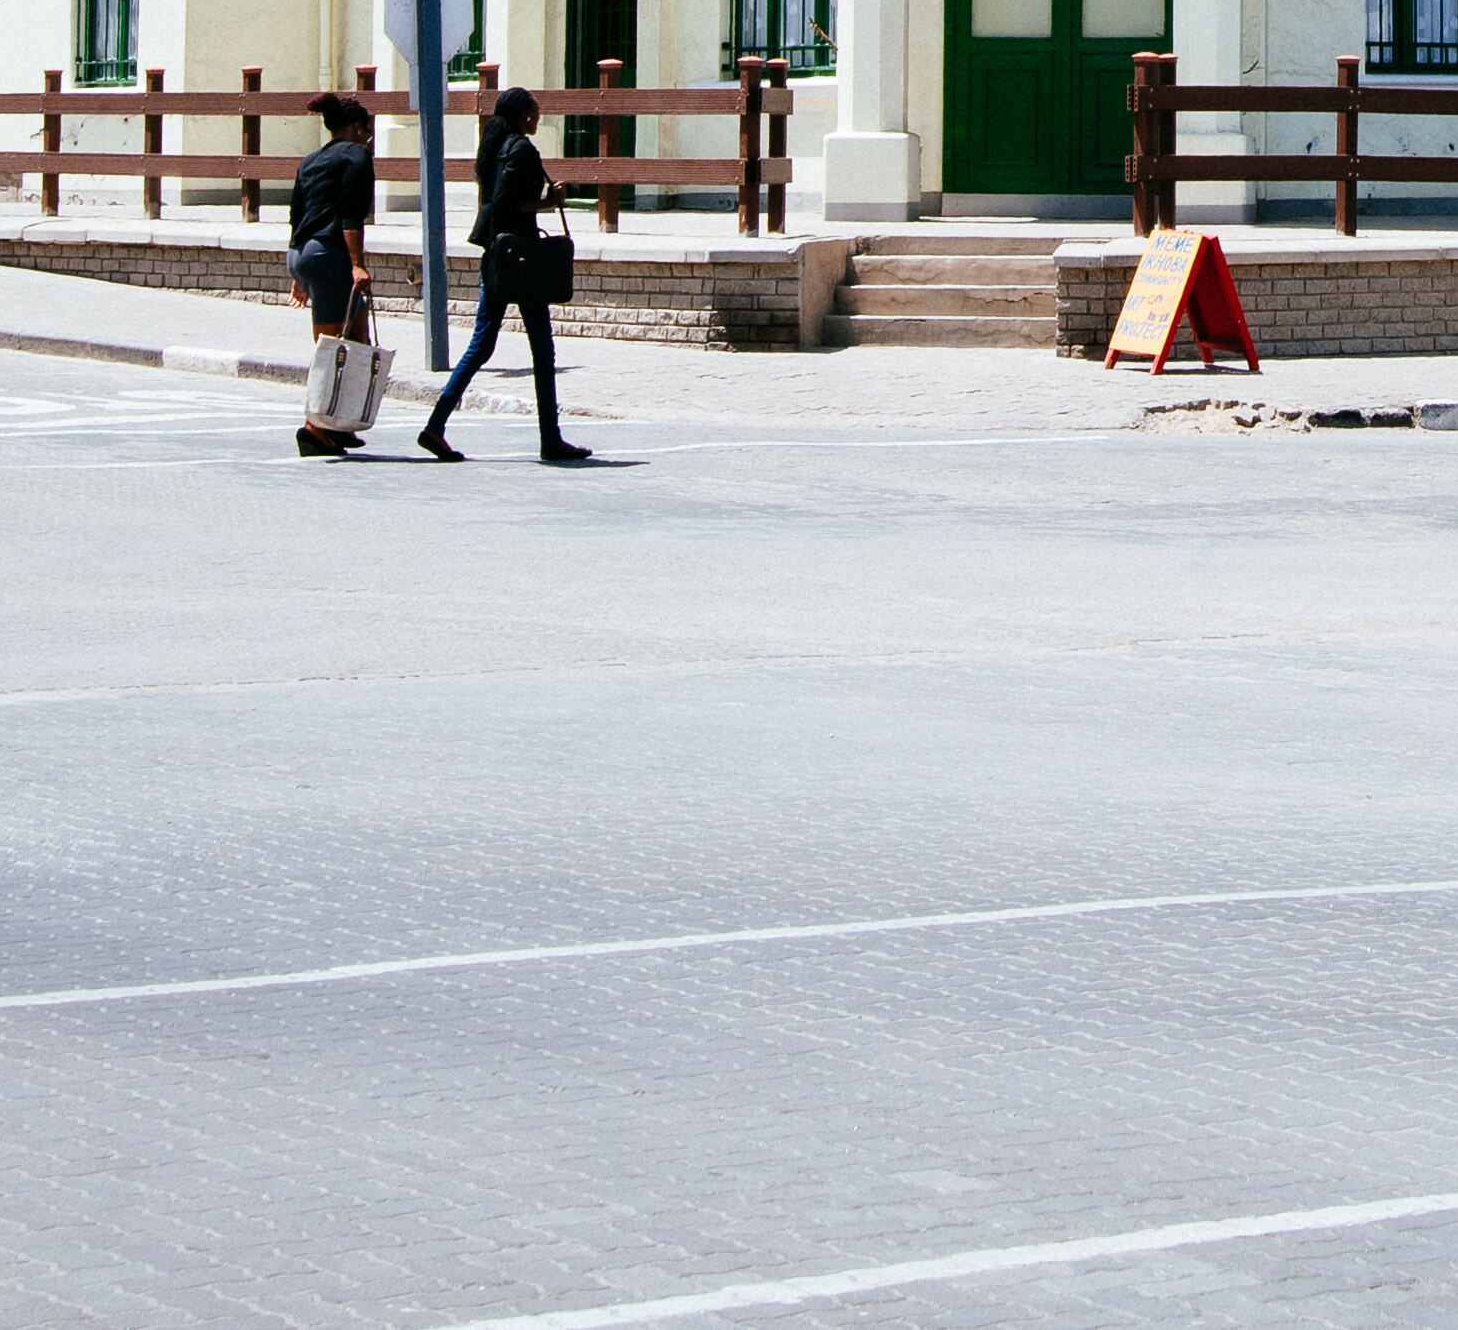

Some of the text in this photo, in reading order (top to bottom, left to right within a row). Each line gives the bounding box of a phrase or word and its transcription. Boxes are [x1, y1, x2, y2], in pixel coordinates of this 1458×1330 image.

[1153, 235, 1196, 253] MEME
[1141, 253, 1189, 271] IKHOBA
[1124, 295, 1146, 311] ART
[1116, 320, 1168, 339] PROJECT
